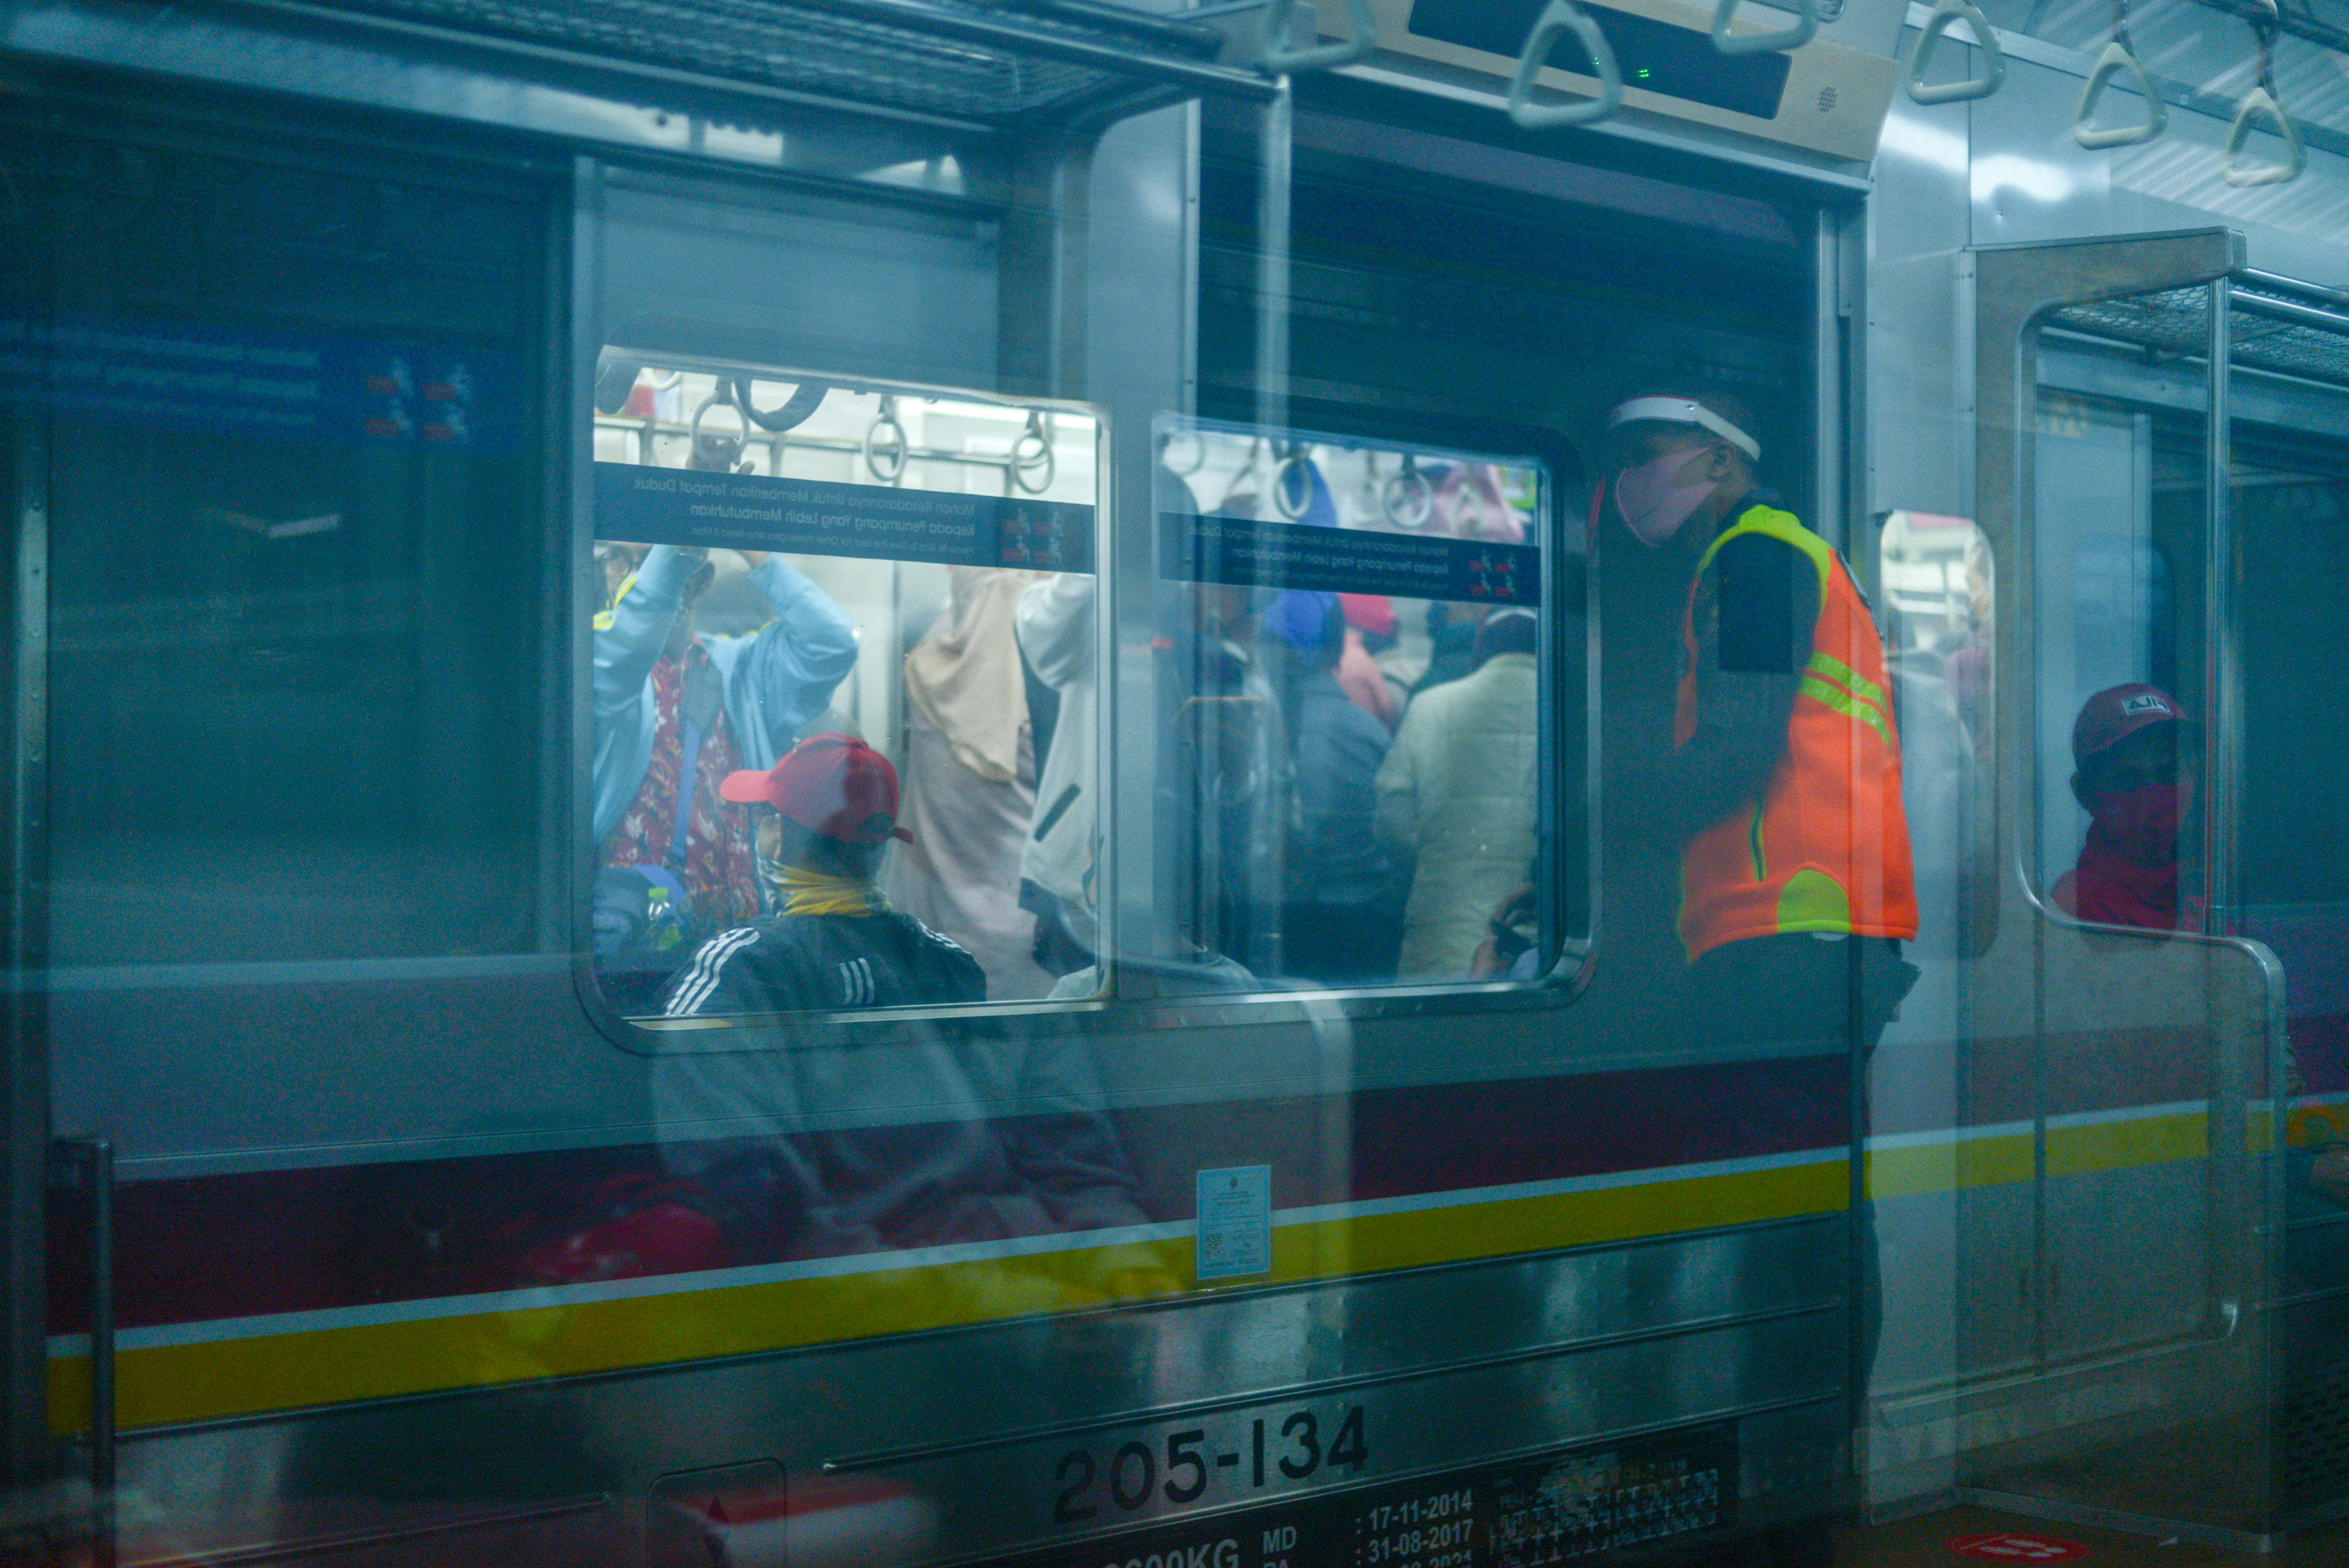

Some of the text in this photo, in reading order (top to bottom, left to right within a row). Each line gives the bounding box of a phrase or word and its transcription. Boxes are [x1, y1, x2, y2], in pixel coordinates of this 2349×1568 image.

[1055, 1405, 1369, 1524] 205-134
[1262, 1525, 1298, 1555] MD
[1369, 1488, 1473, 1531] 17-11-2014
[1367, 1518, 1474, 1563] 31-08-2017
